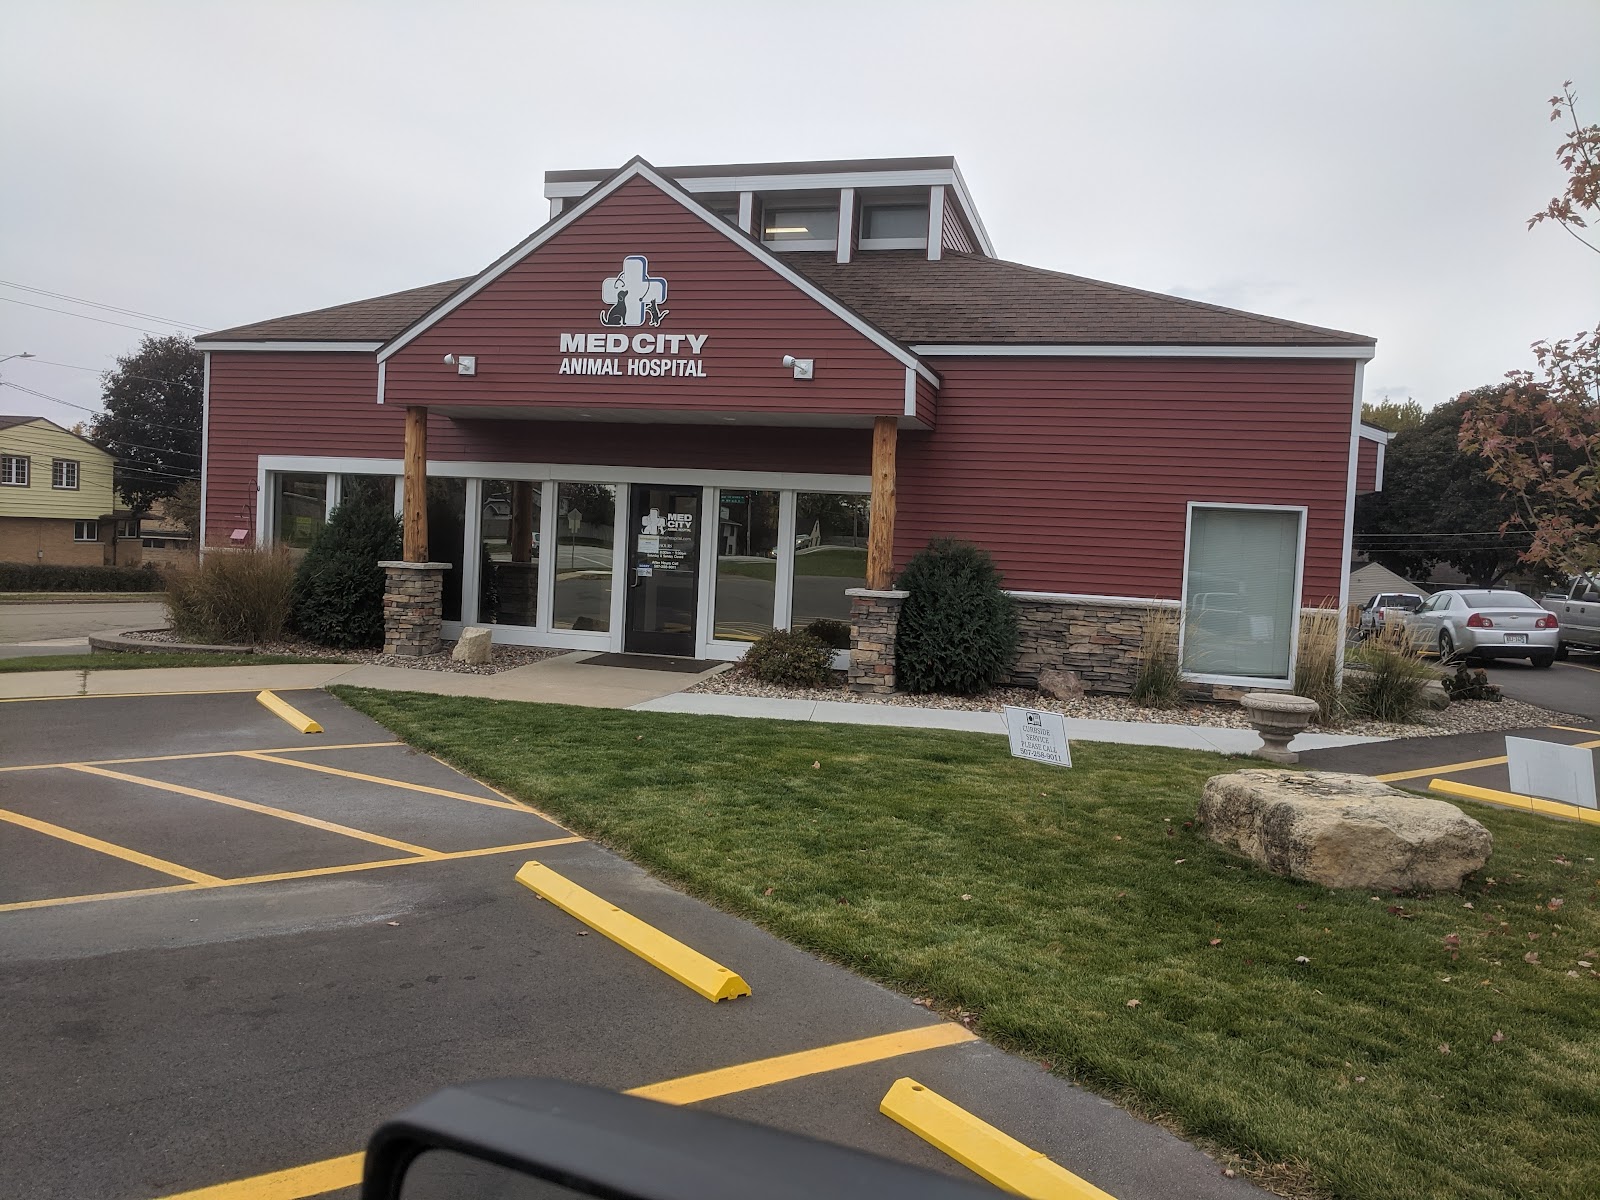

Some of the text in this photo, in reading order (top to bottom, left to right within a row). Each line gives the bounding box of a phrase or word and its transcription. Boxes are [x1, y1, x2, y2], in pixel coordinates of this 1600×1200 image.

[559, 333, 709, 355] MED CITY
[558, 358, 707, 378] ANIMAL HOSPITAL
[1022, 725, 1051, 736] CURBSIDE
[1025, 733, 1050, 744] SERVICE
[1021, 740, 1058, 754] PLEASE CALL
[1020, 747, 1062, 762] 507-258-9011
